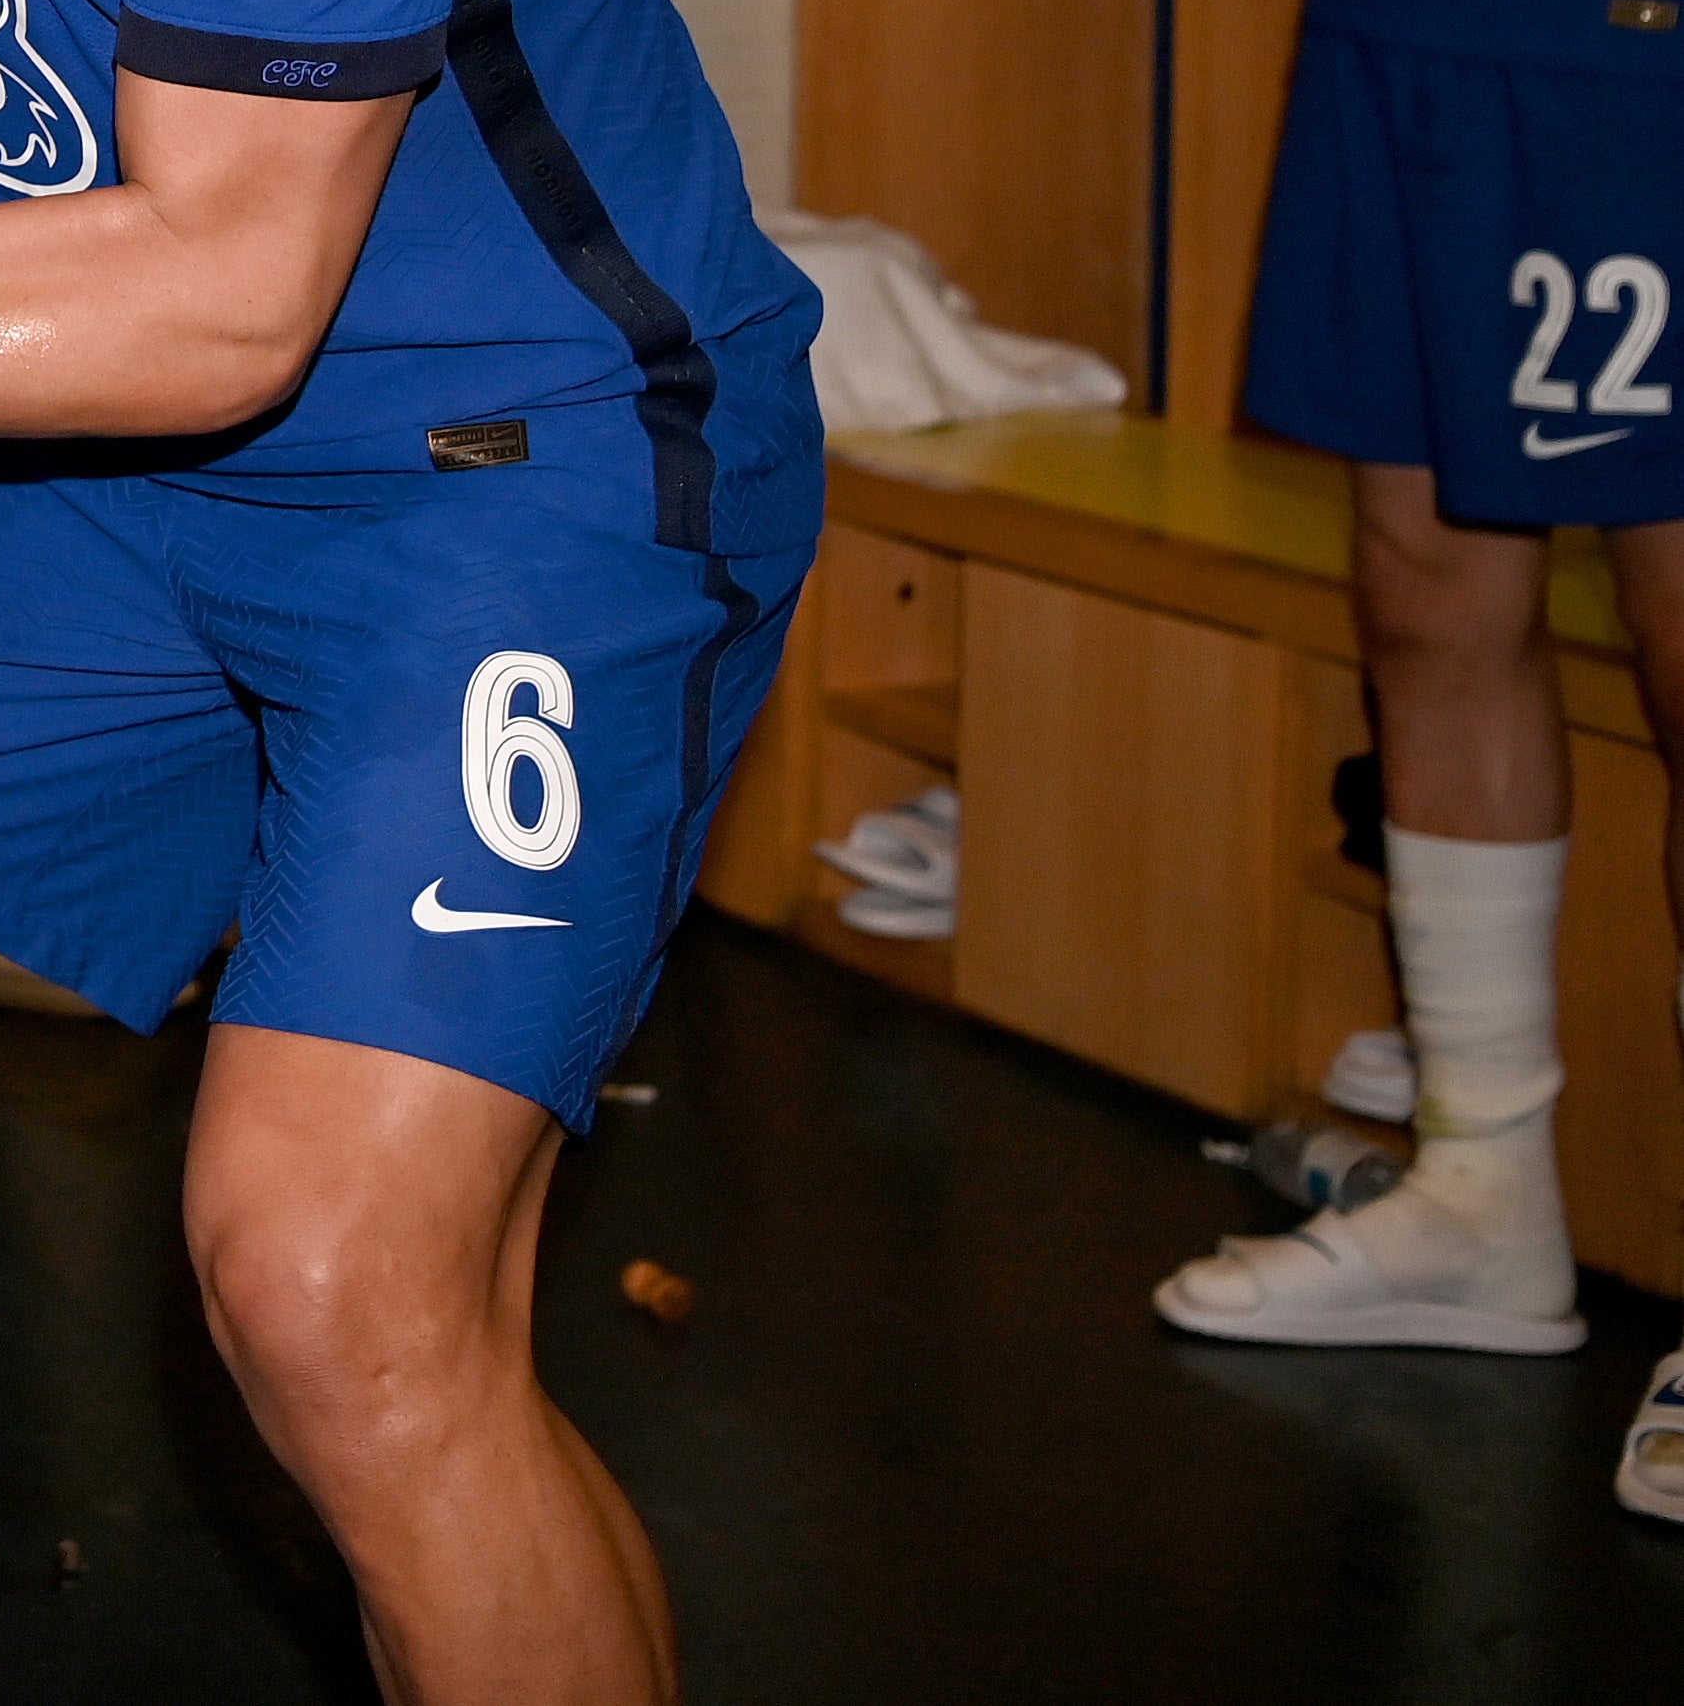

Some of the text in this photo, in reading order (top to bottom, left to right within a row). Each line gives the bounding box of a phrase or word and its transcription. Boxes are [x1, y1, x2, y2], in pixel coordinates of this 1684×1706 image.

[262, 59, 338, 88] CFC
[1511, 250, 1673, 416] 22
[461, 650, 581, 871] 6
